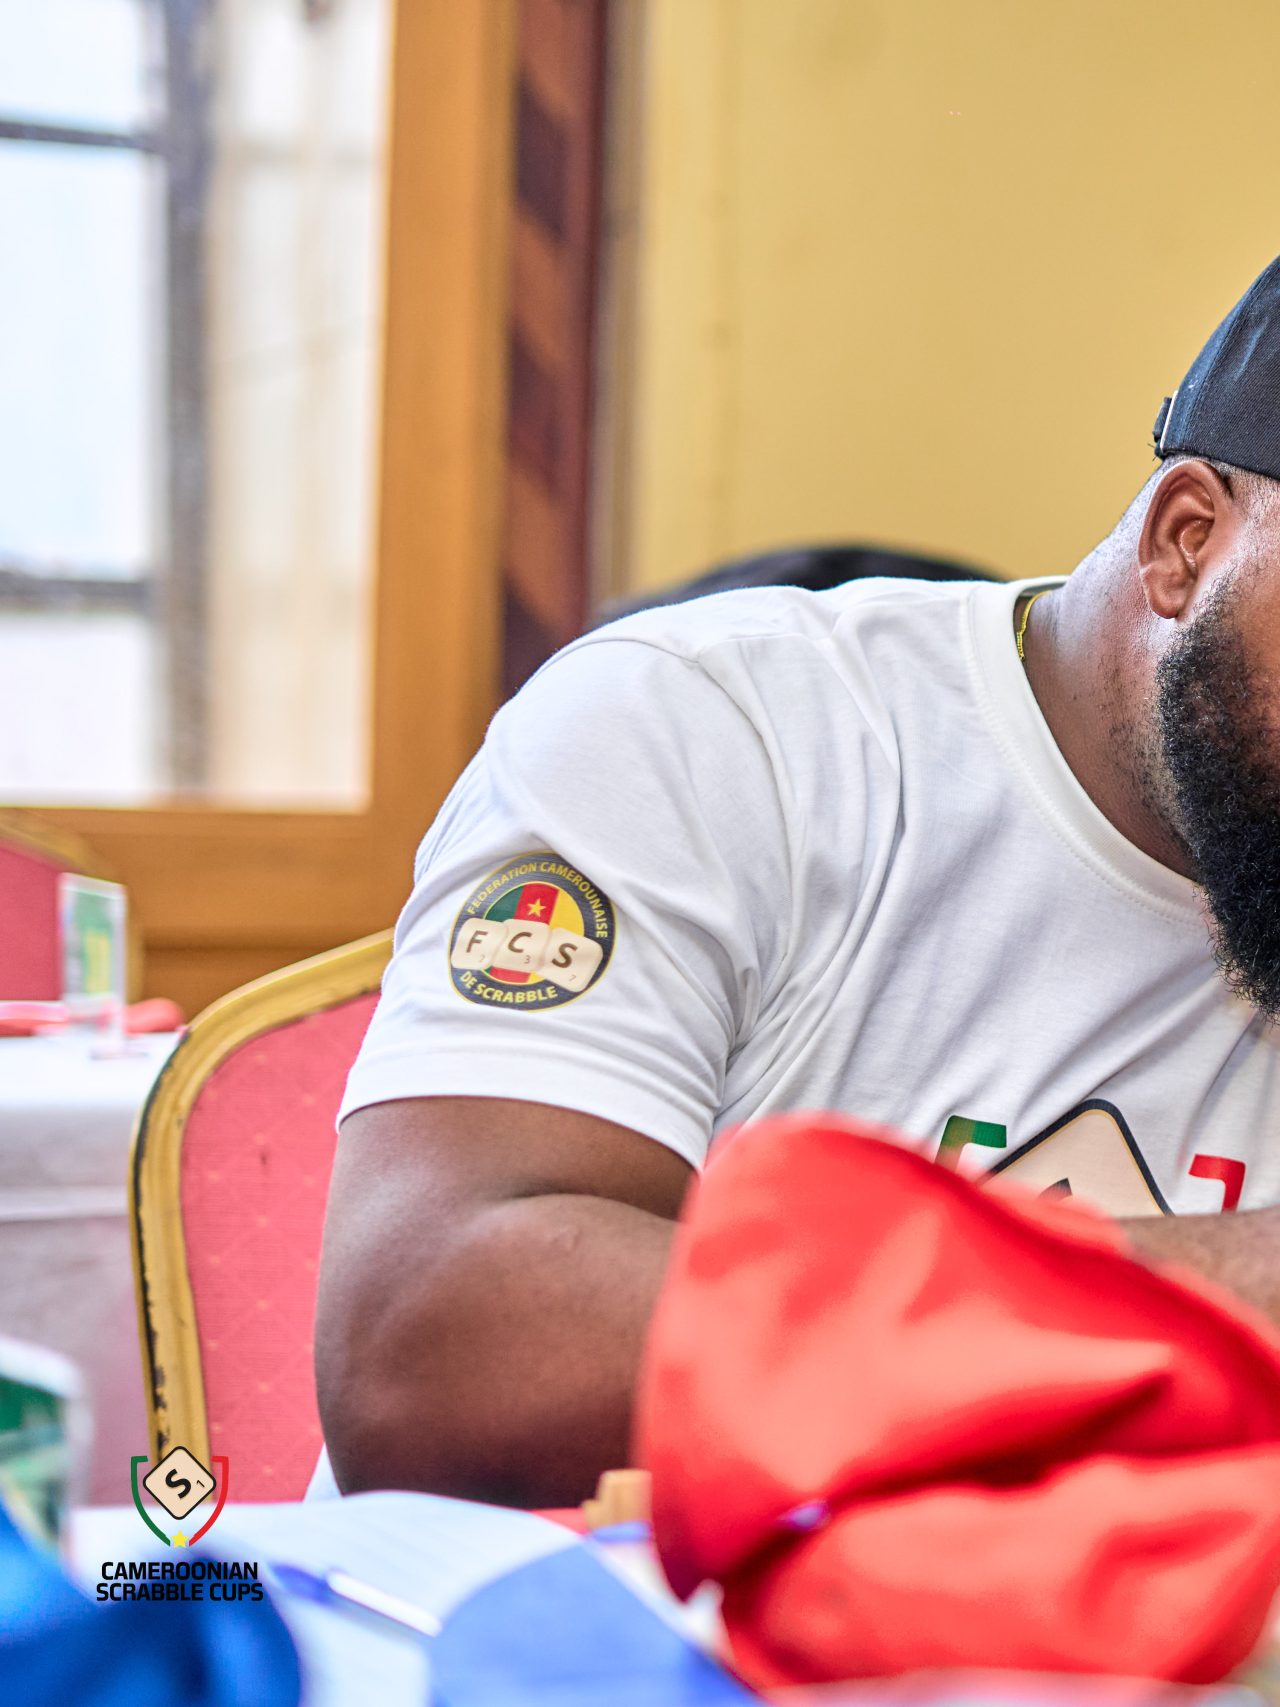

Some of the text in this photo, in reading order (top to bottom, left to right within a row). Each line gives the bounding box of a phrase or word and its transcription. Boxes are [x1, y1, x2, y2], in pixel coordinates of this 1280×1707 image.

[468, 861, 608, 939] FEDERATION CAMEROUNAISE
[460, 971, 558, 1004] DE SCRABBLE
